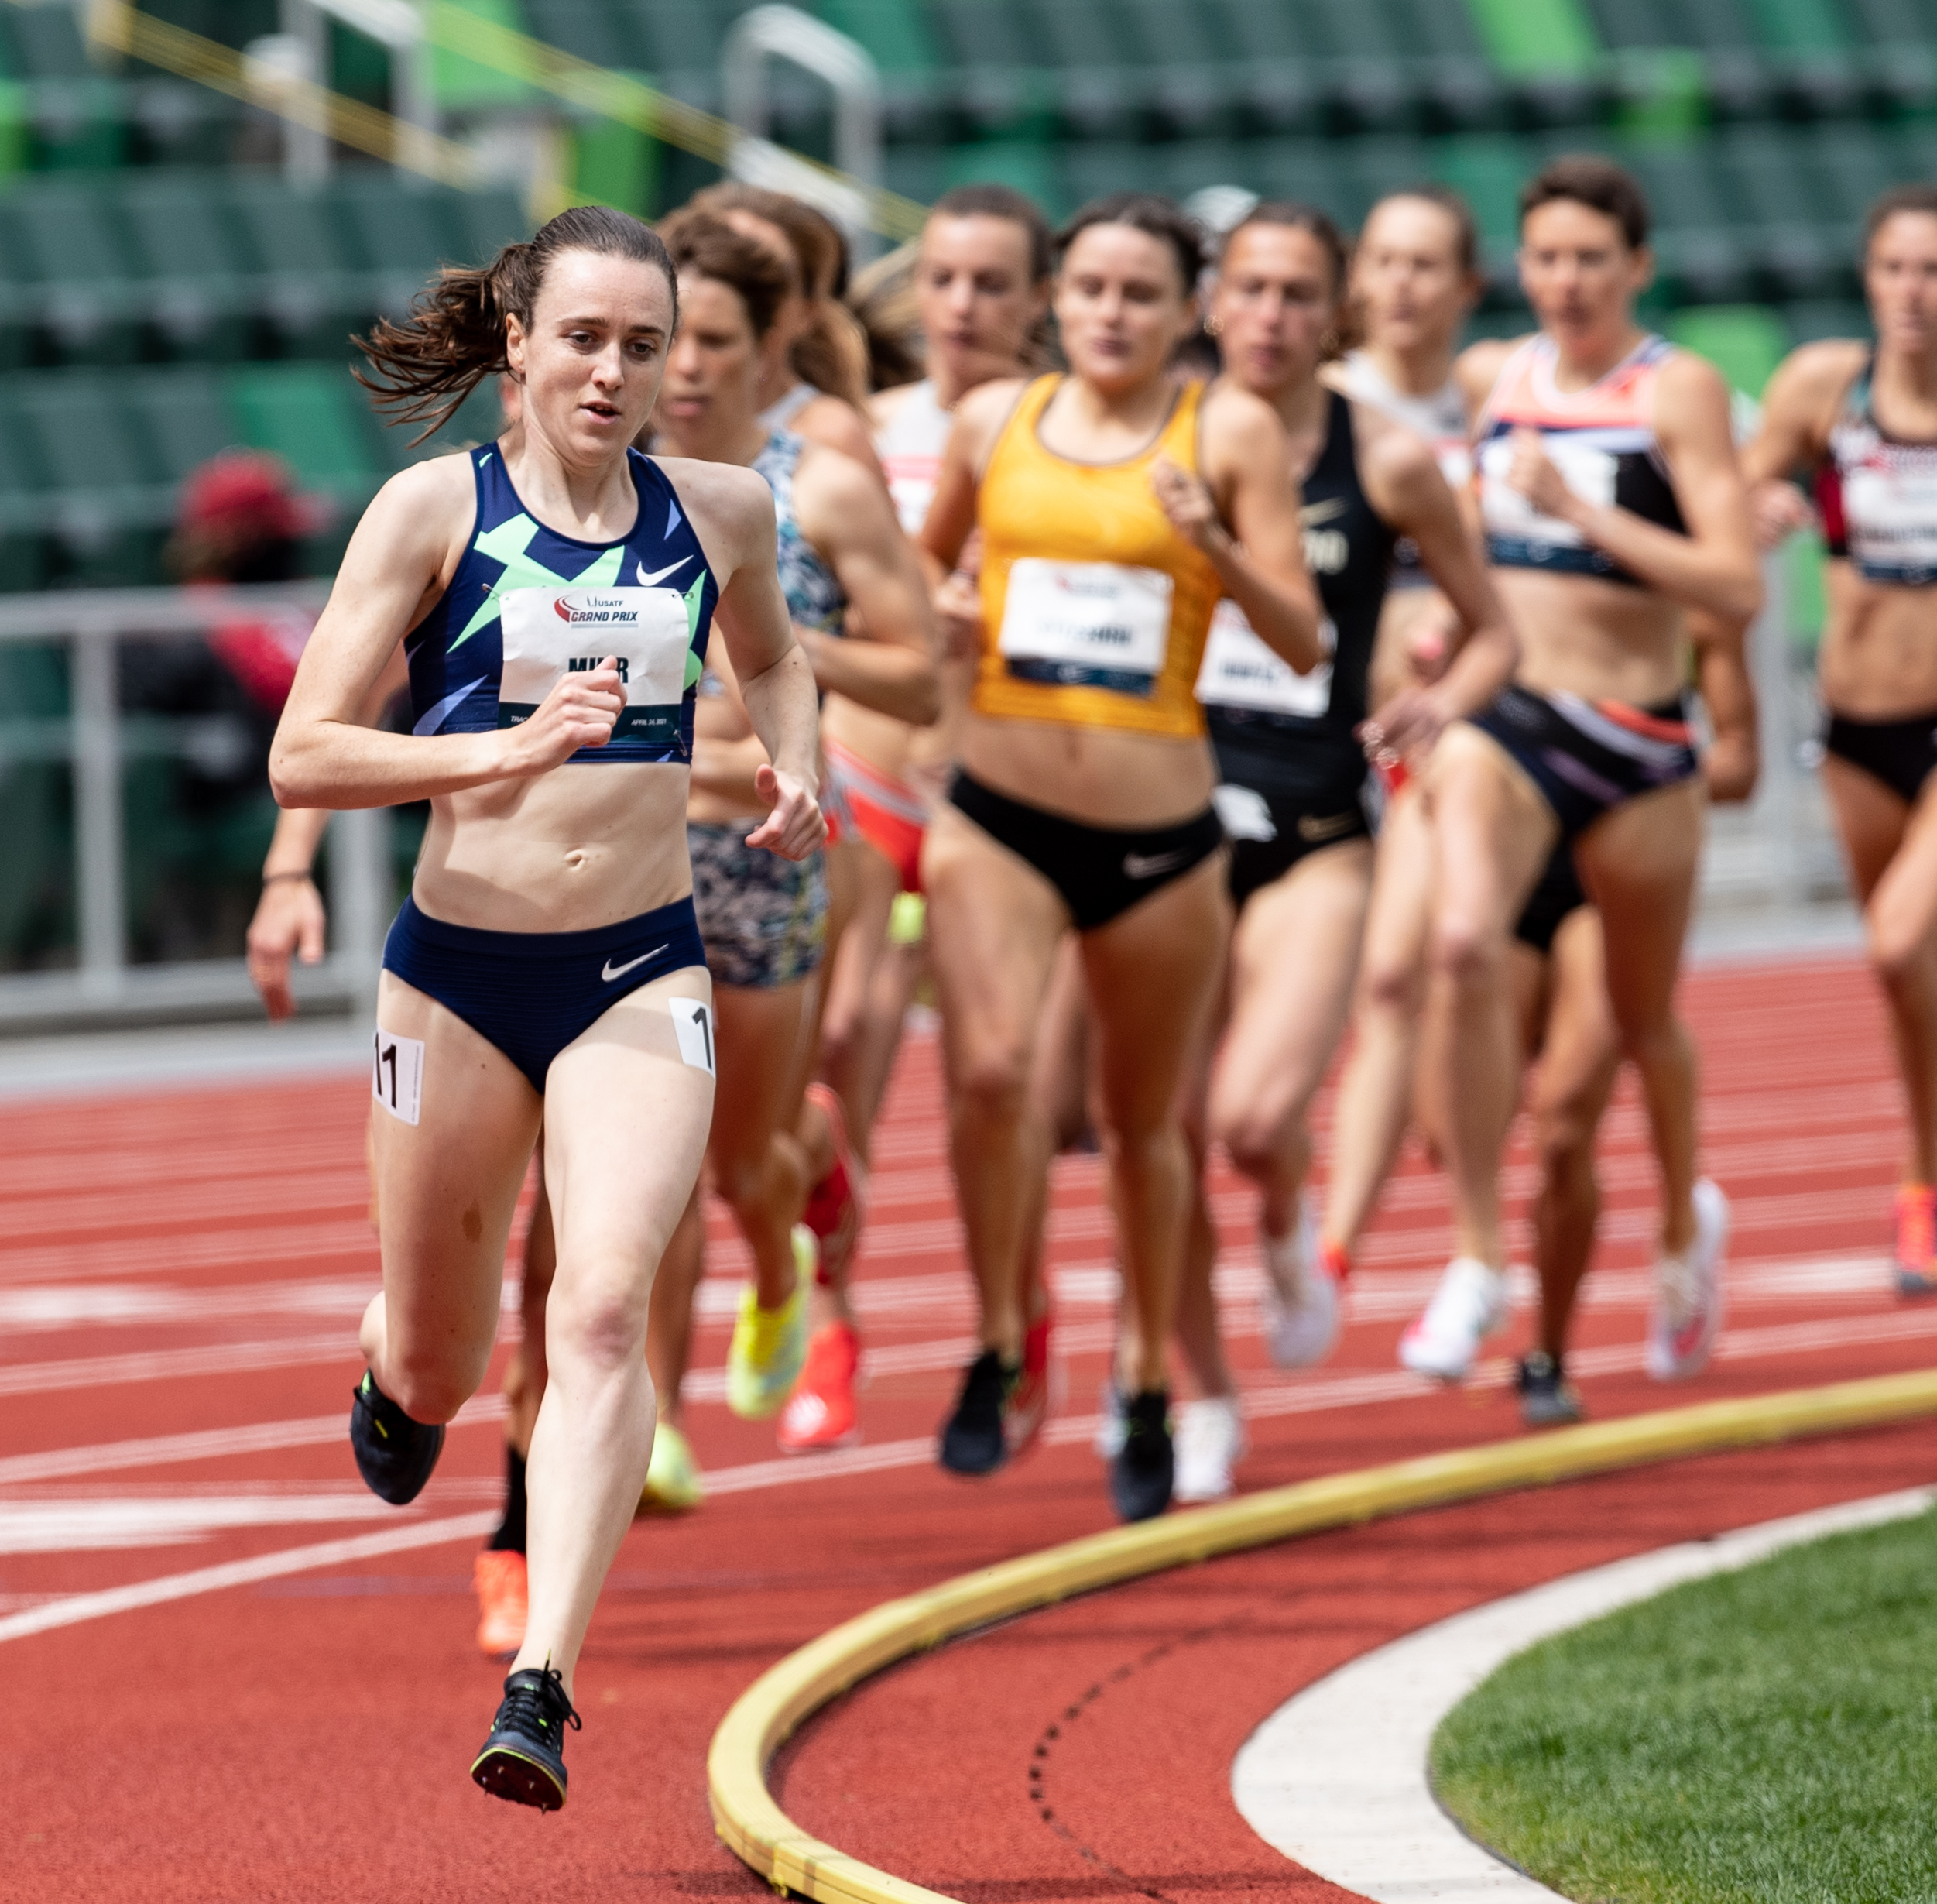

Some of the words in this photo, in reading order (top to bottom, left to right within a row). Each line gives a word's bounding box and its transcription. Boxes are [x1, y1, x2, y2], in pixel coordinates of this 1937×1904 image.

[571, 611, 609, 622] GRAND
[612, 610, 639, 622] PRIX
[568, 657, 629, 684] MR
